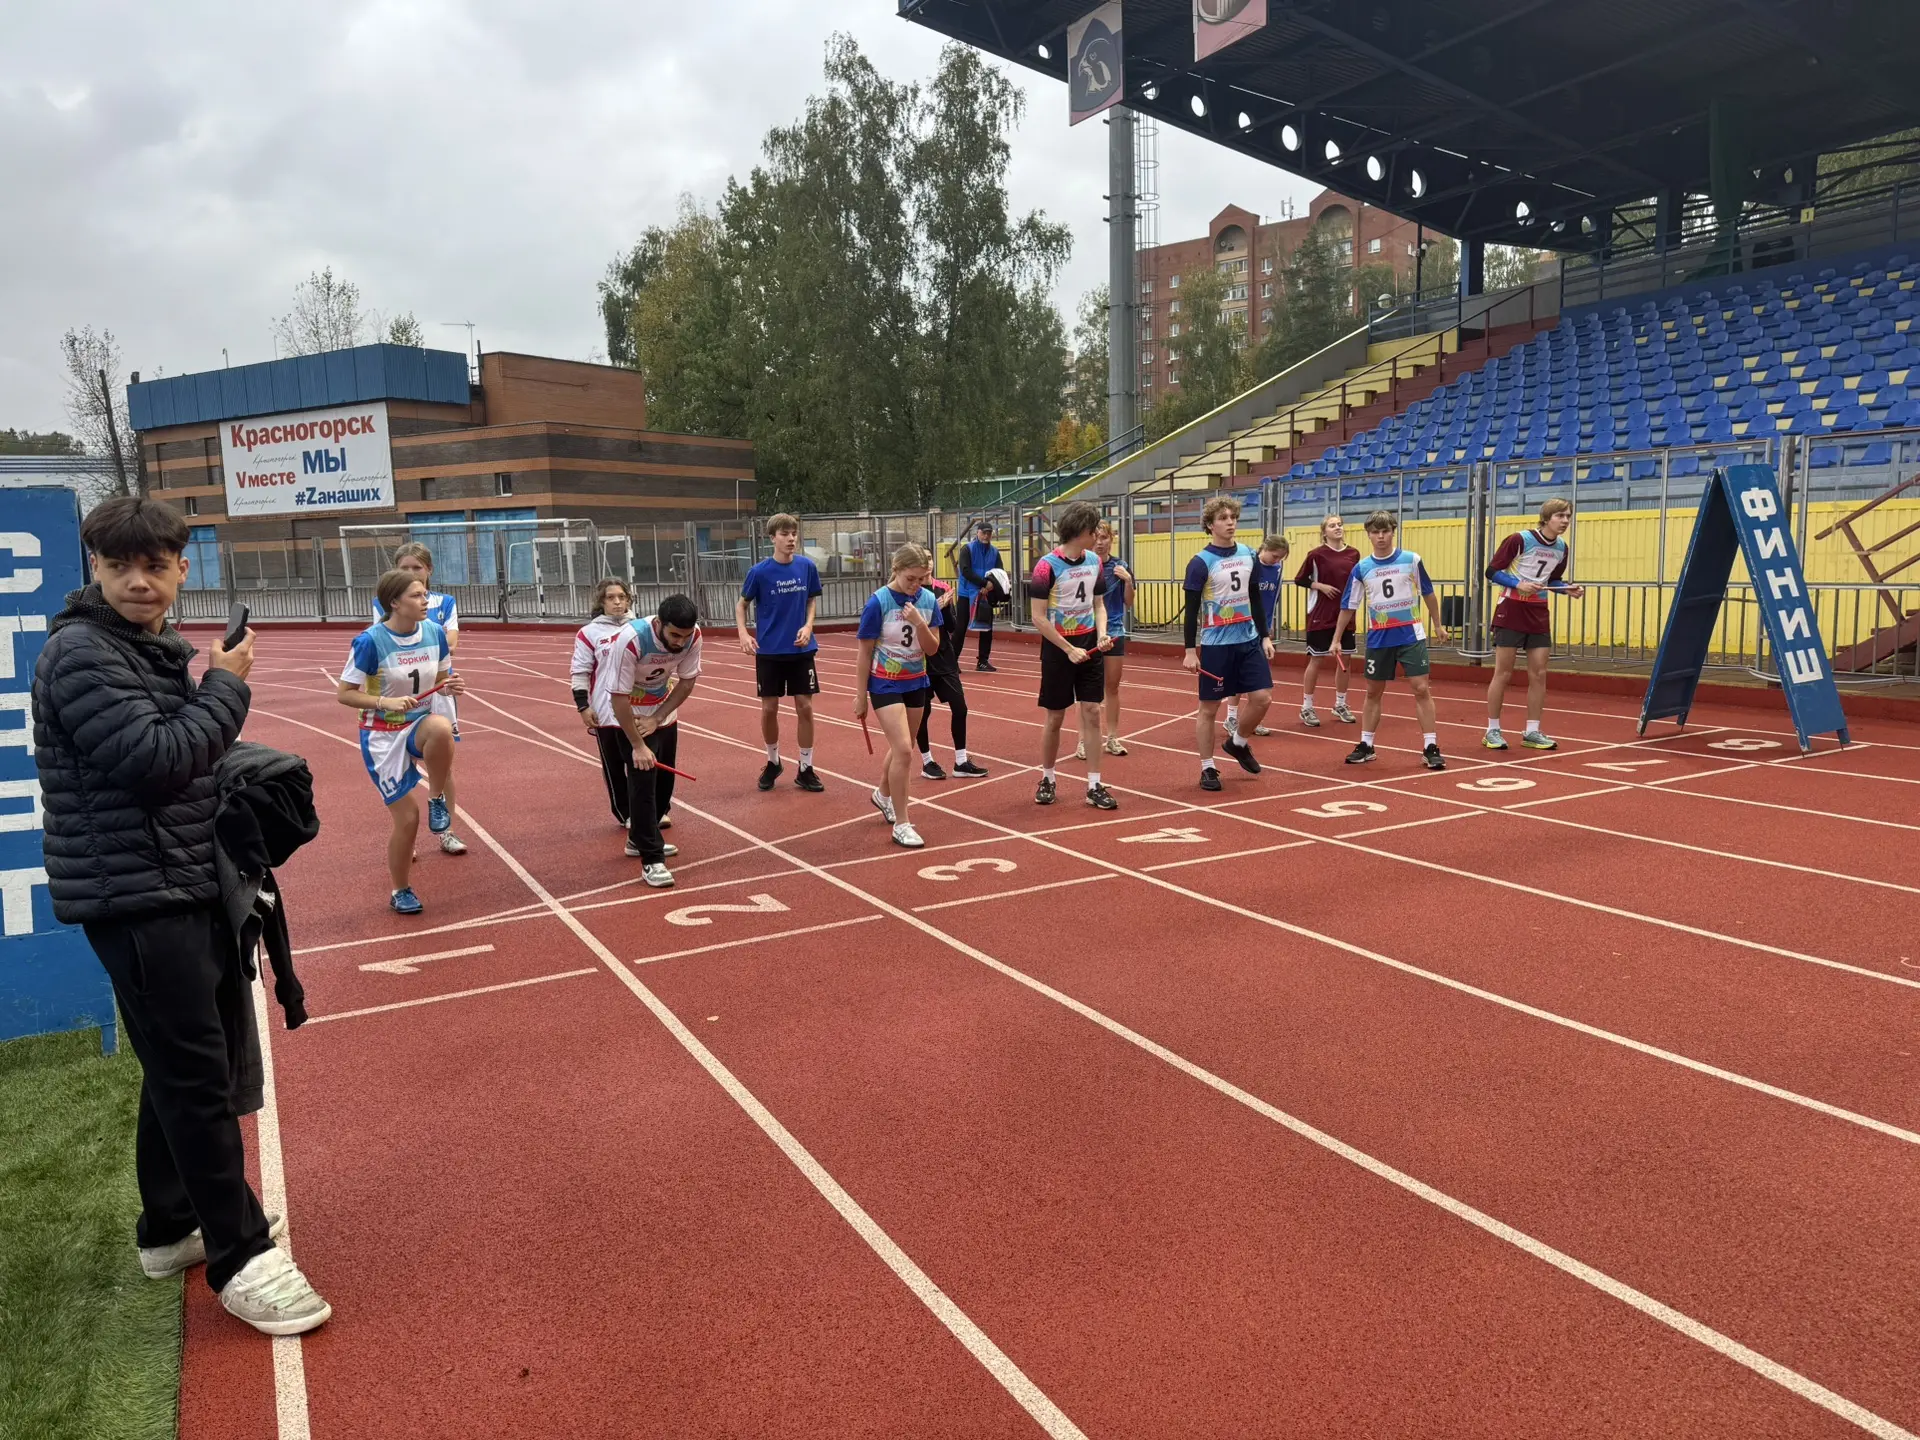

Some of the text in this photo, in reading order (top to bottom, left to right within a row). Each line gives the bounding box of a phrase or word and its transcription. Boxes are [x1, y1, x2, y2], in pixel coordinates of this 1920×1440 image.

[230, 415, 376, 452] Красногорск
[253, 453, 298, 469] Красногорск
[302, 448, 347, 474] МЫ
[236, 471, 296, 489] Vместе
[340, 472, 389, 488] Красногорск
[234, 496, 276, 512] Красногорск
[295, 487, 382, 506] #Zанаших
[1536, 560, 1548, 578] 7
[1230, 571, 1241, 592] 5
[1382, 578, 1394, 598] 6
[1740, 488, 1824, 684] ФИНИШ
[1076, 581, 1086, 602] 4
[900, 624, 912, 647] 3
[397, 652, 430, 666] Зоркий
[1366, 660, 1376, 674] 3
[408, 668, 420, 694] 1
[646, 668, 664, 681] 2
[808, 669, 815, 686] 2
[1707, 738, 1782, 750] 8
[1581, 760, 1669, 772] 7
[382, 776, 402, 794] 11
[1456, 777, 1536, 792] 6
[1291, 801, 1388, 818] 5
[1116, 827, 1212, 843] 4
[917, 858, 1018, 881] 3
[664, 893, 792, 926] 2
[358, 944, 495, 974] 1
